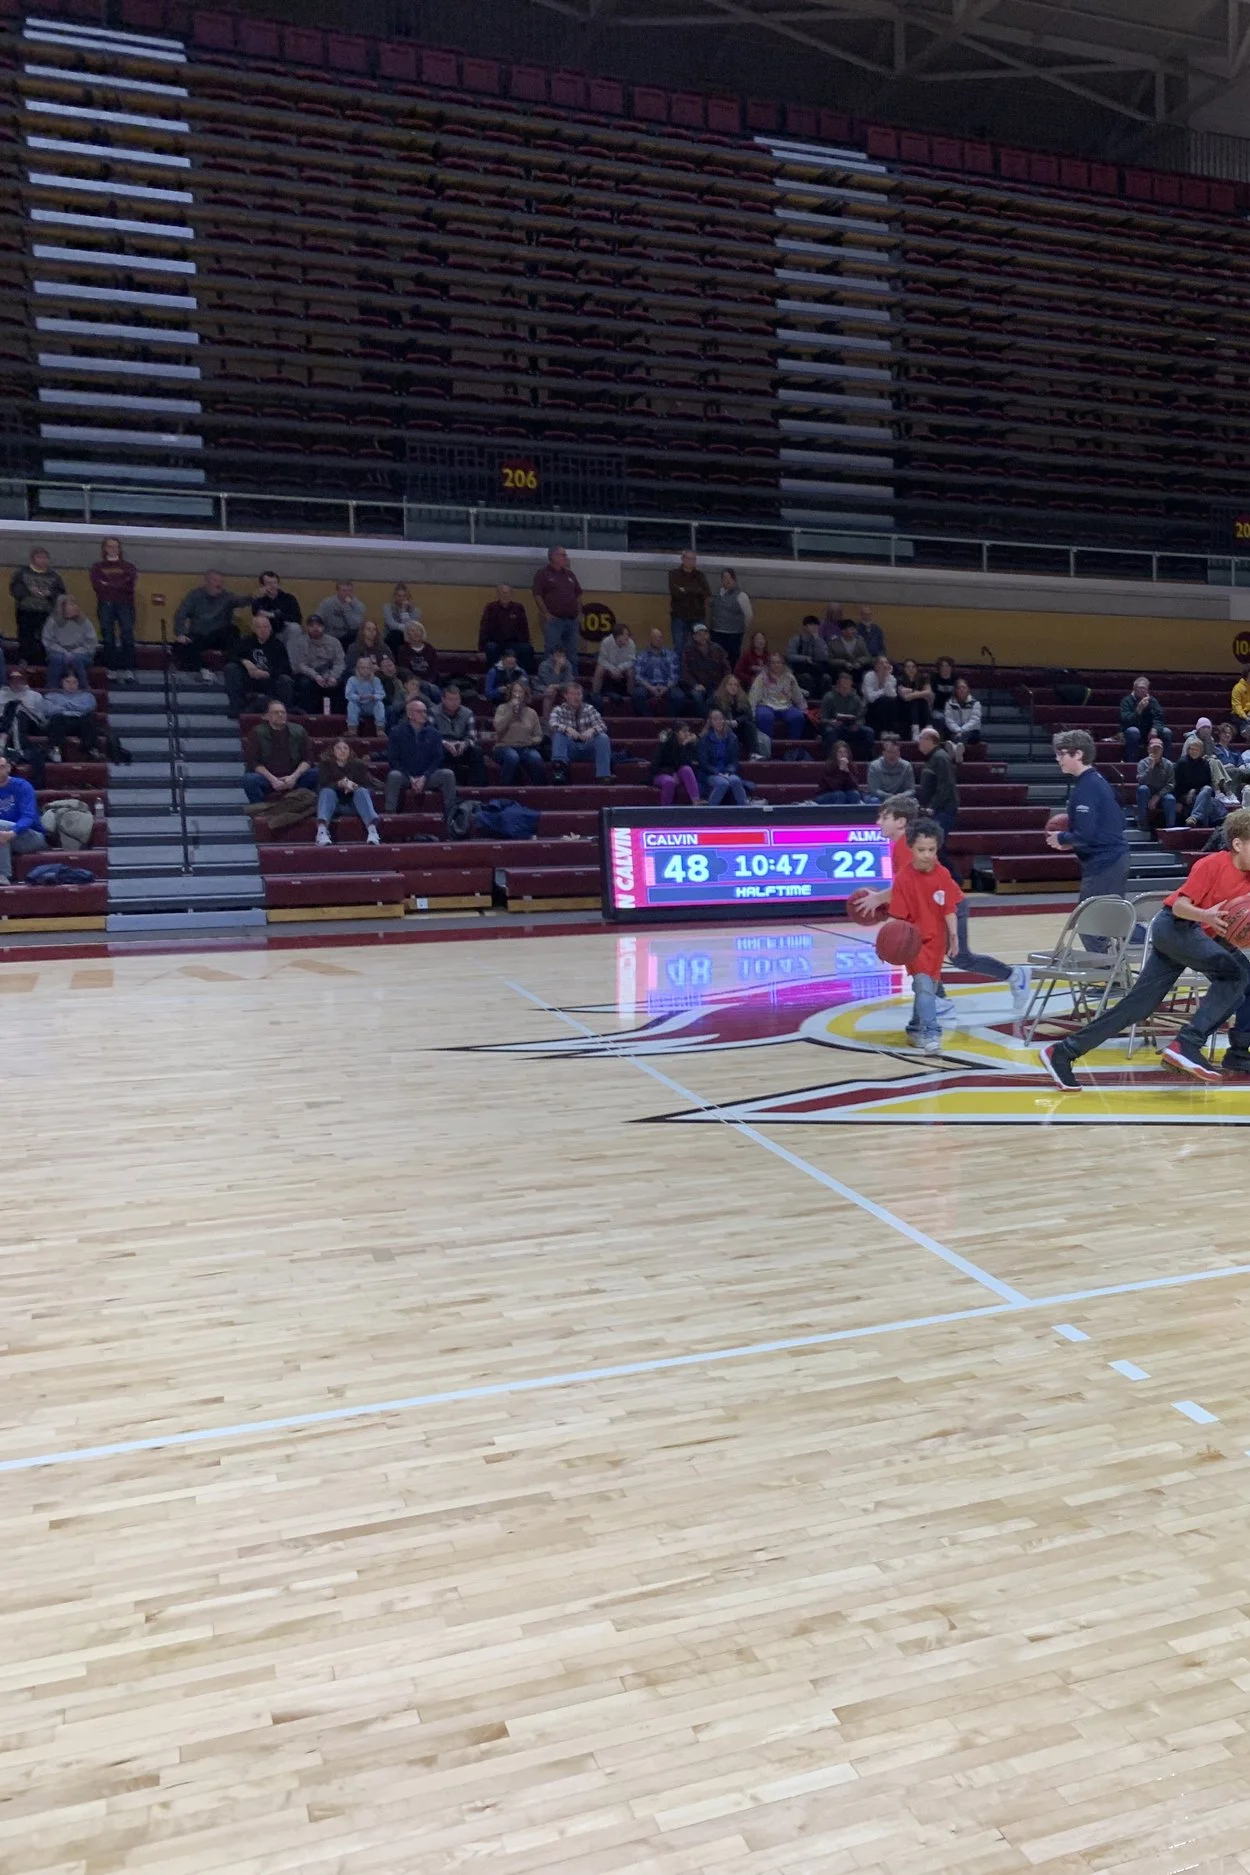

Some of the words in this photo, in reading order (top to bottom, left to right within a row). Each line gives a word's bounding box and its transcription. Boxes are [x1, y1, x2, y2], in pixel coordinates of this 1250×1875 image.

[502, 468, 537, 488] 206
[646, 833, 698, 846] CALVIN
[613, 828, 635, 891] CALVIN
[664, 854, 710, 883] 48
[735, 853, 809, 877] 10:47
[832, 850, 876, 878] 22
[736, 884, 812, 898] HALFTIME
